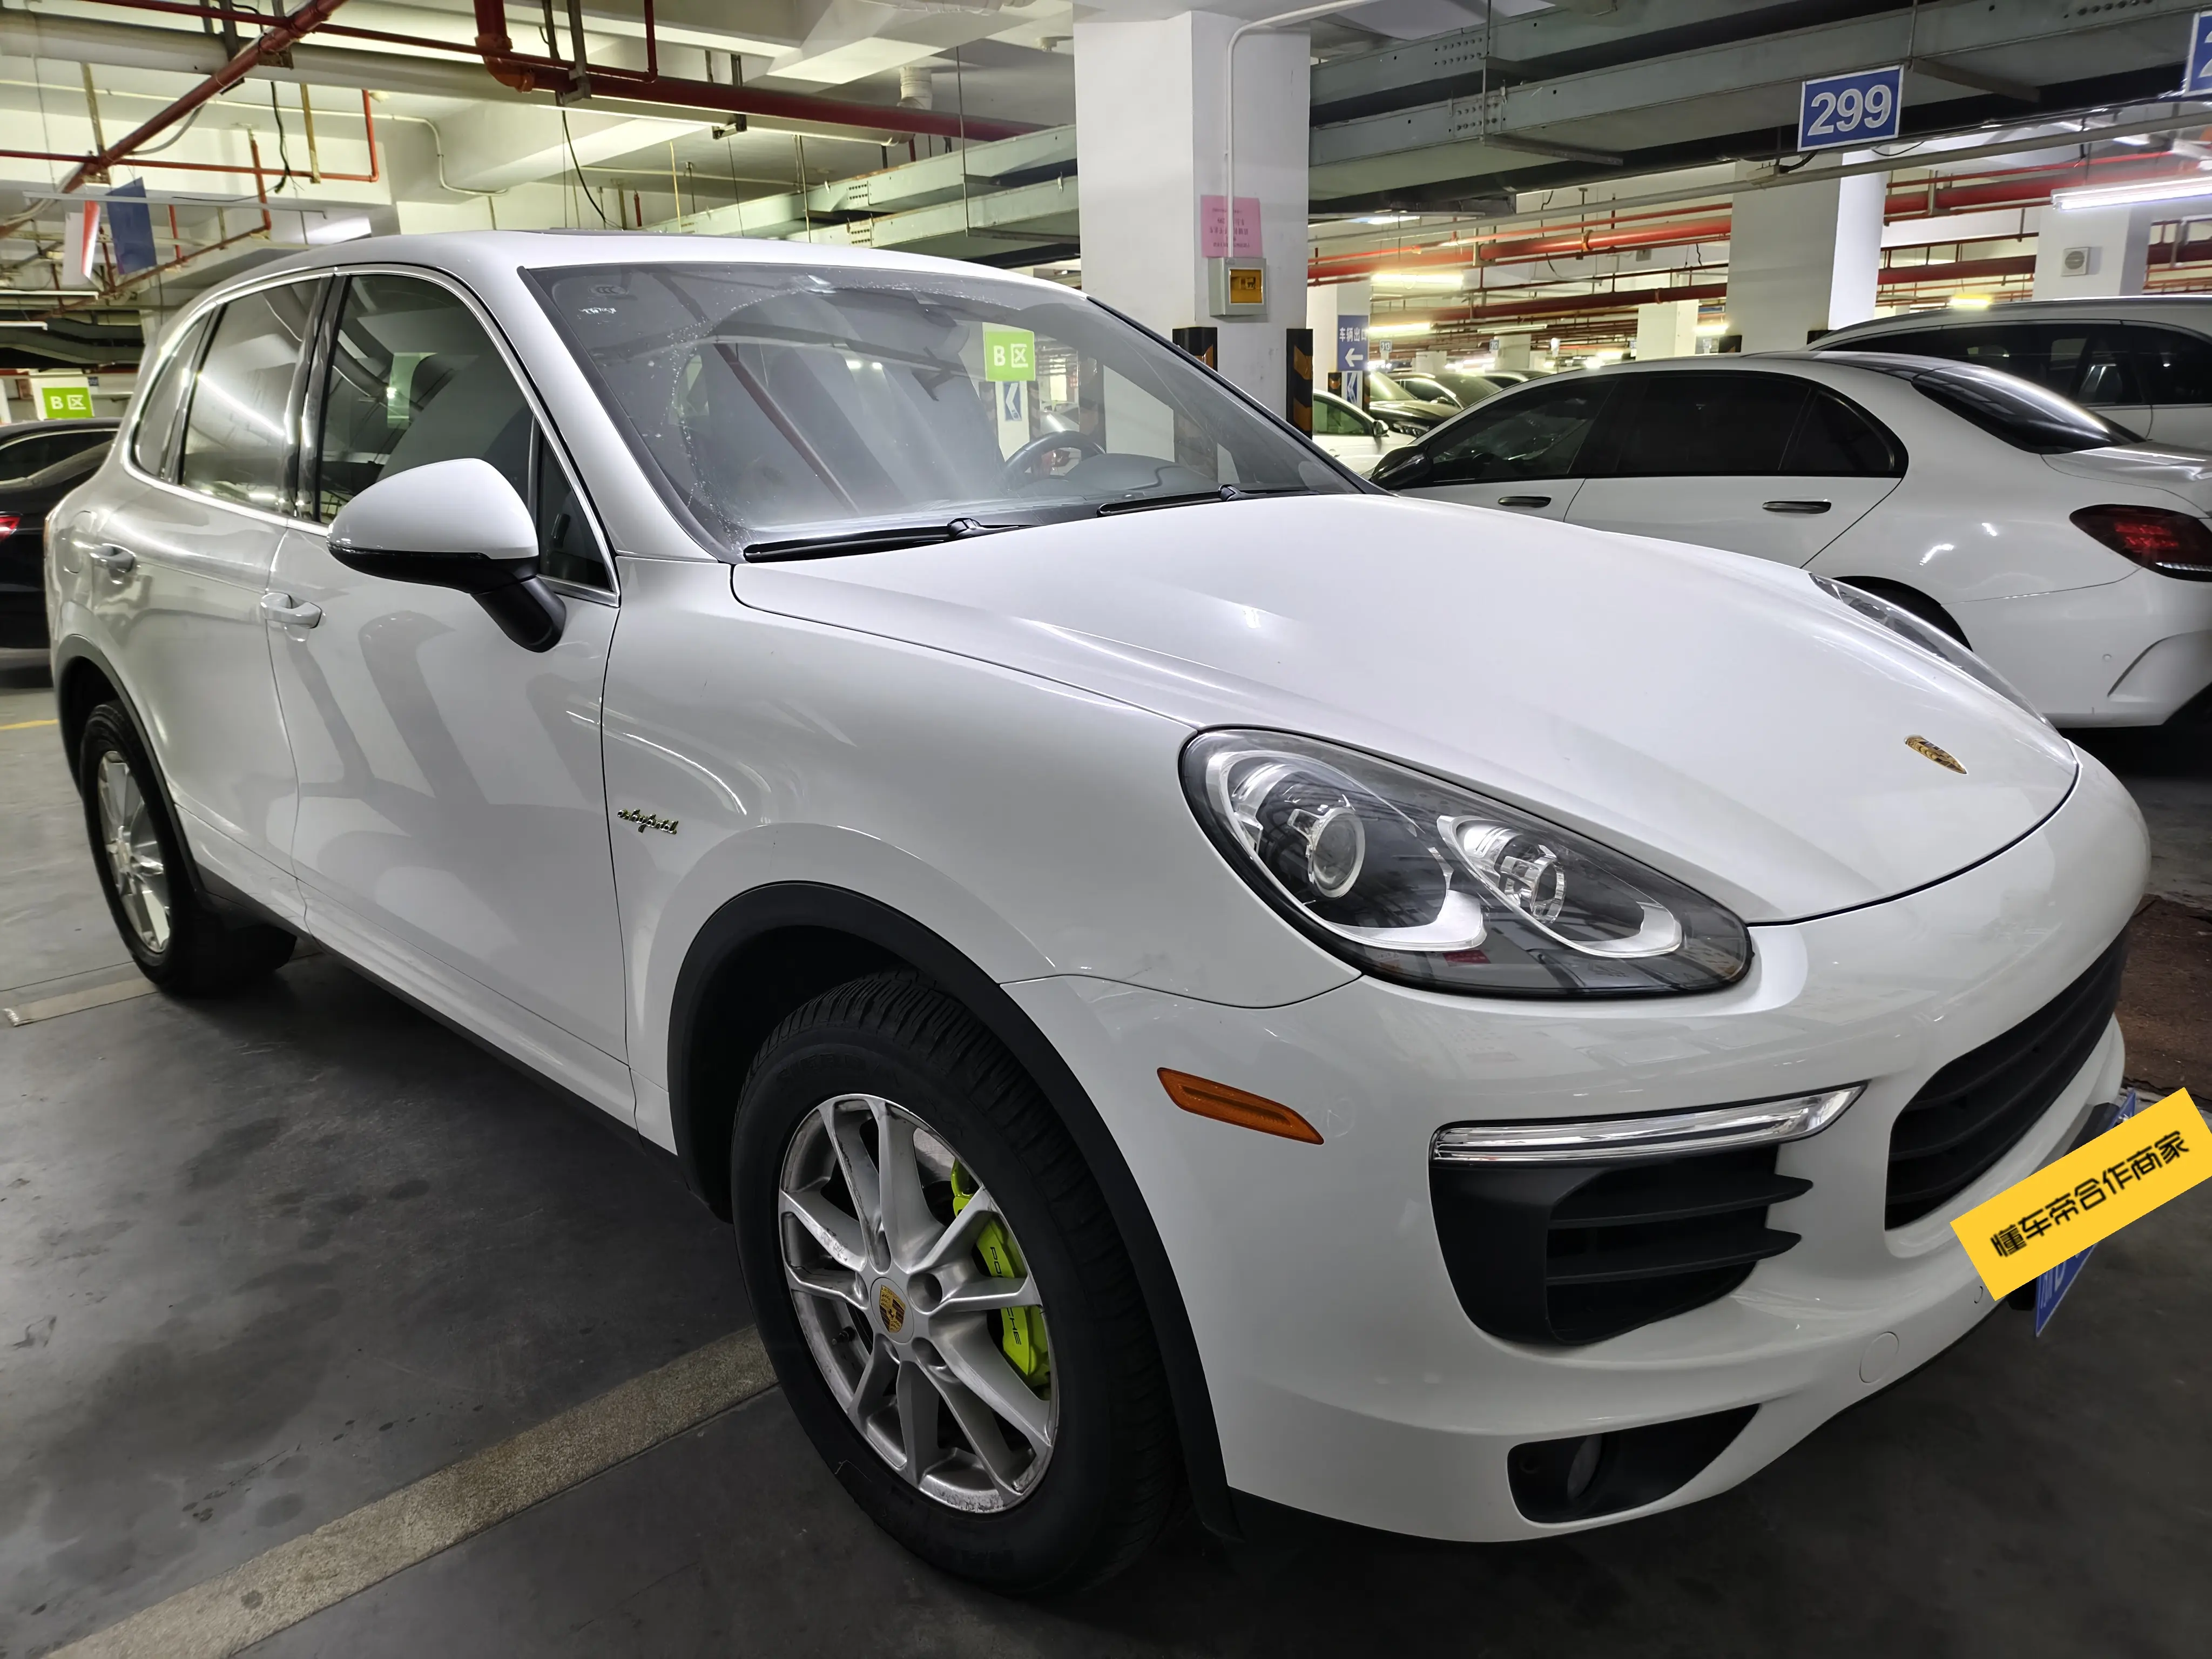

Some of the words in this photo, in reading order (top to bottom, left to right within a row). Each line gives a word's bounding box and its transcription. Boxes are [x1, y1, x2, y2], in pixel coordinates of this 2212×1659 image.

[1807, 84, 1892, 136] 299
[1339, 327, 1367, 342] 车辆出口
[990, 1246, 1022, 1345] POCHE
